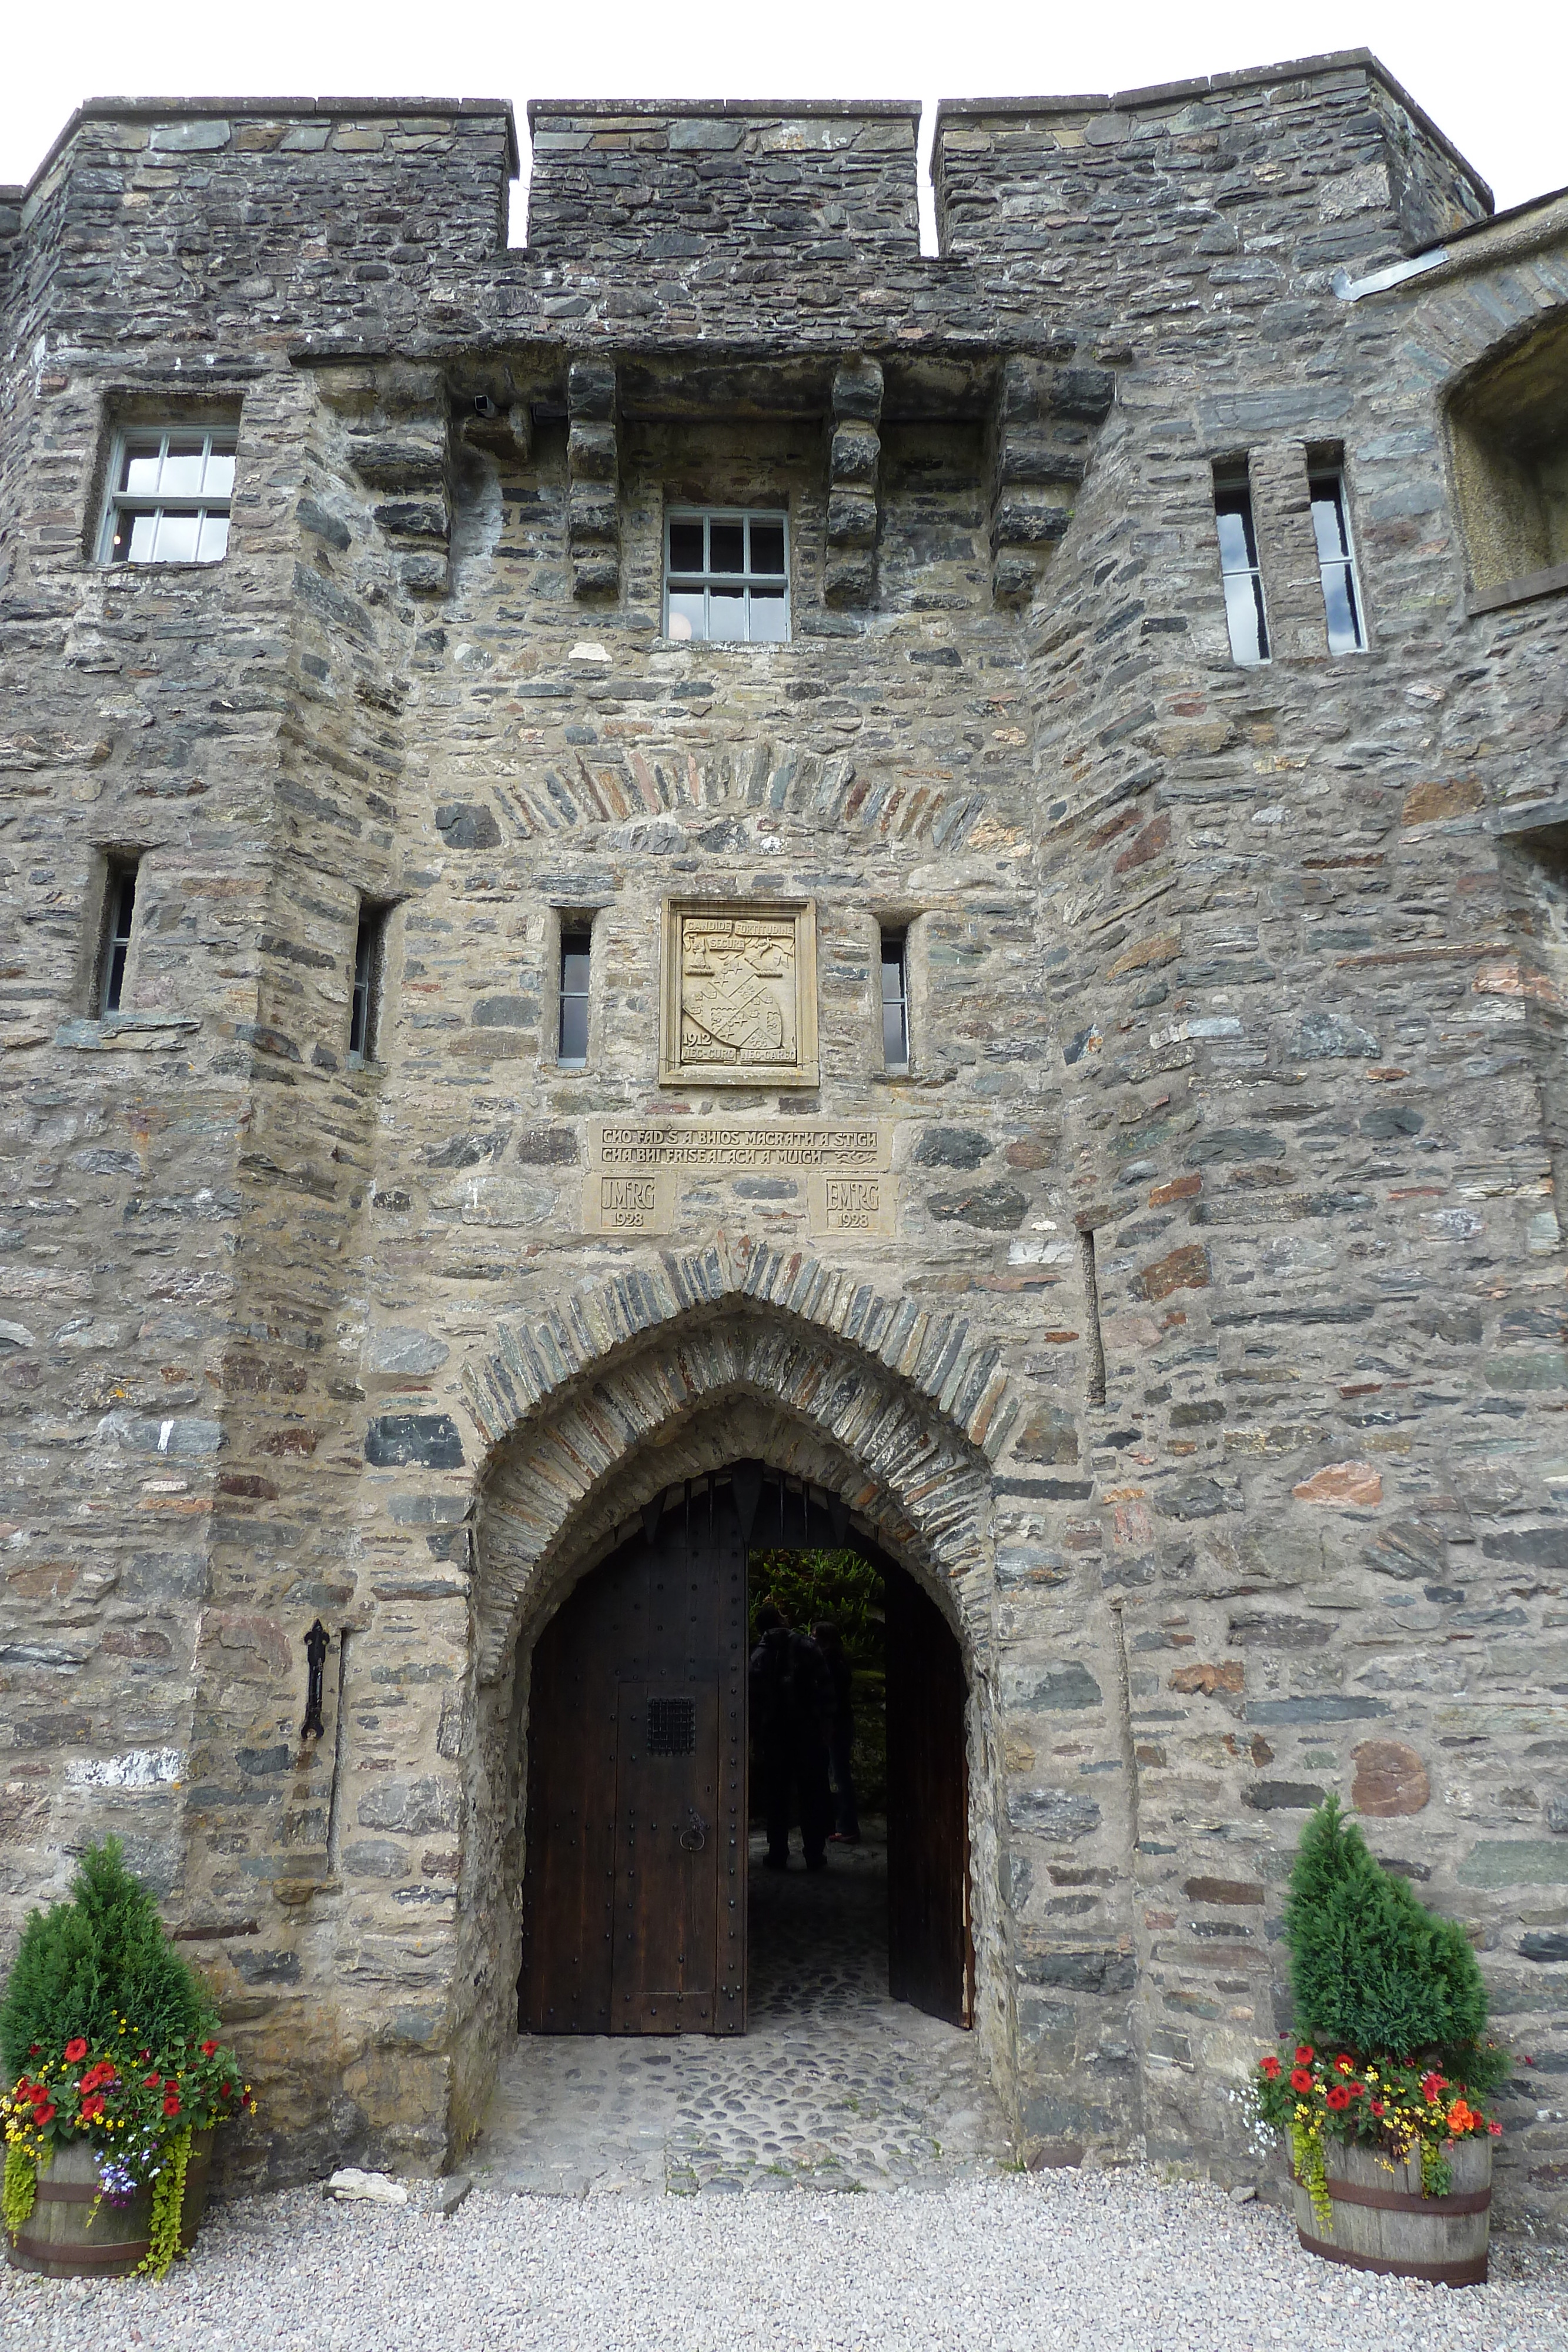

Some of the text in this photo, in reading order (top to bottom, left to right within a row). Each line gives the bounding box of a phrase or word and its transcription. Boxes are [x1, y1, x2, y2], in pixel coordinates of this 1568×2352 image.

[687, 921, 731, 931] CANDIDE
[736, 924, 794, 935] FORTITUDINE
[710, 939, 745, 948] SECURE
[683, 1033, 712, 1047] 1912
[683, 1048, 735, 1059] NEC-CURO
[741, 1050, 795, 1061] NEC-CAREO
[603, 1130, 632, 1144] CHO
[637, 1130, 663, 1144] FAD
[682, 1130, 693, 1144] A
[697, 1131, 740, 1145] BHIOS
[744, 1131, 815, 1146] MACRATH
[818, 1132, 830, 1146] A
[833, 1132, 878, 1147] STIGH
[603, 1148, 828, 1165] CHA BHI FRISEALACH A MUIGH.
